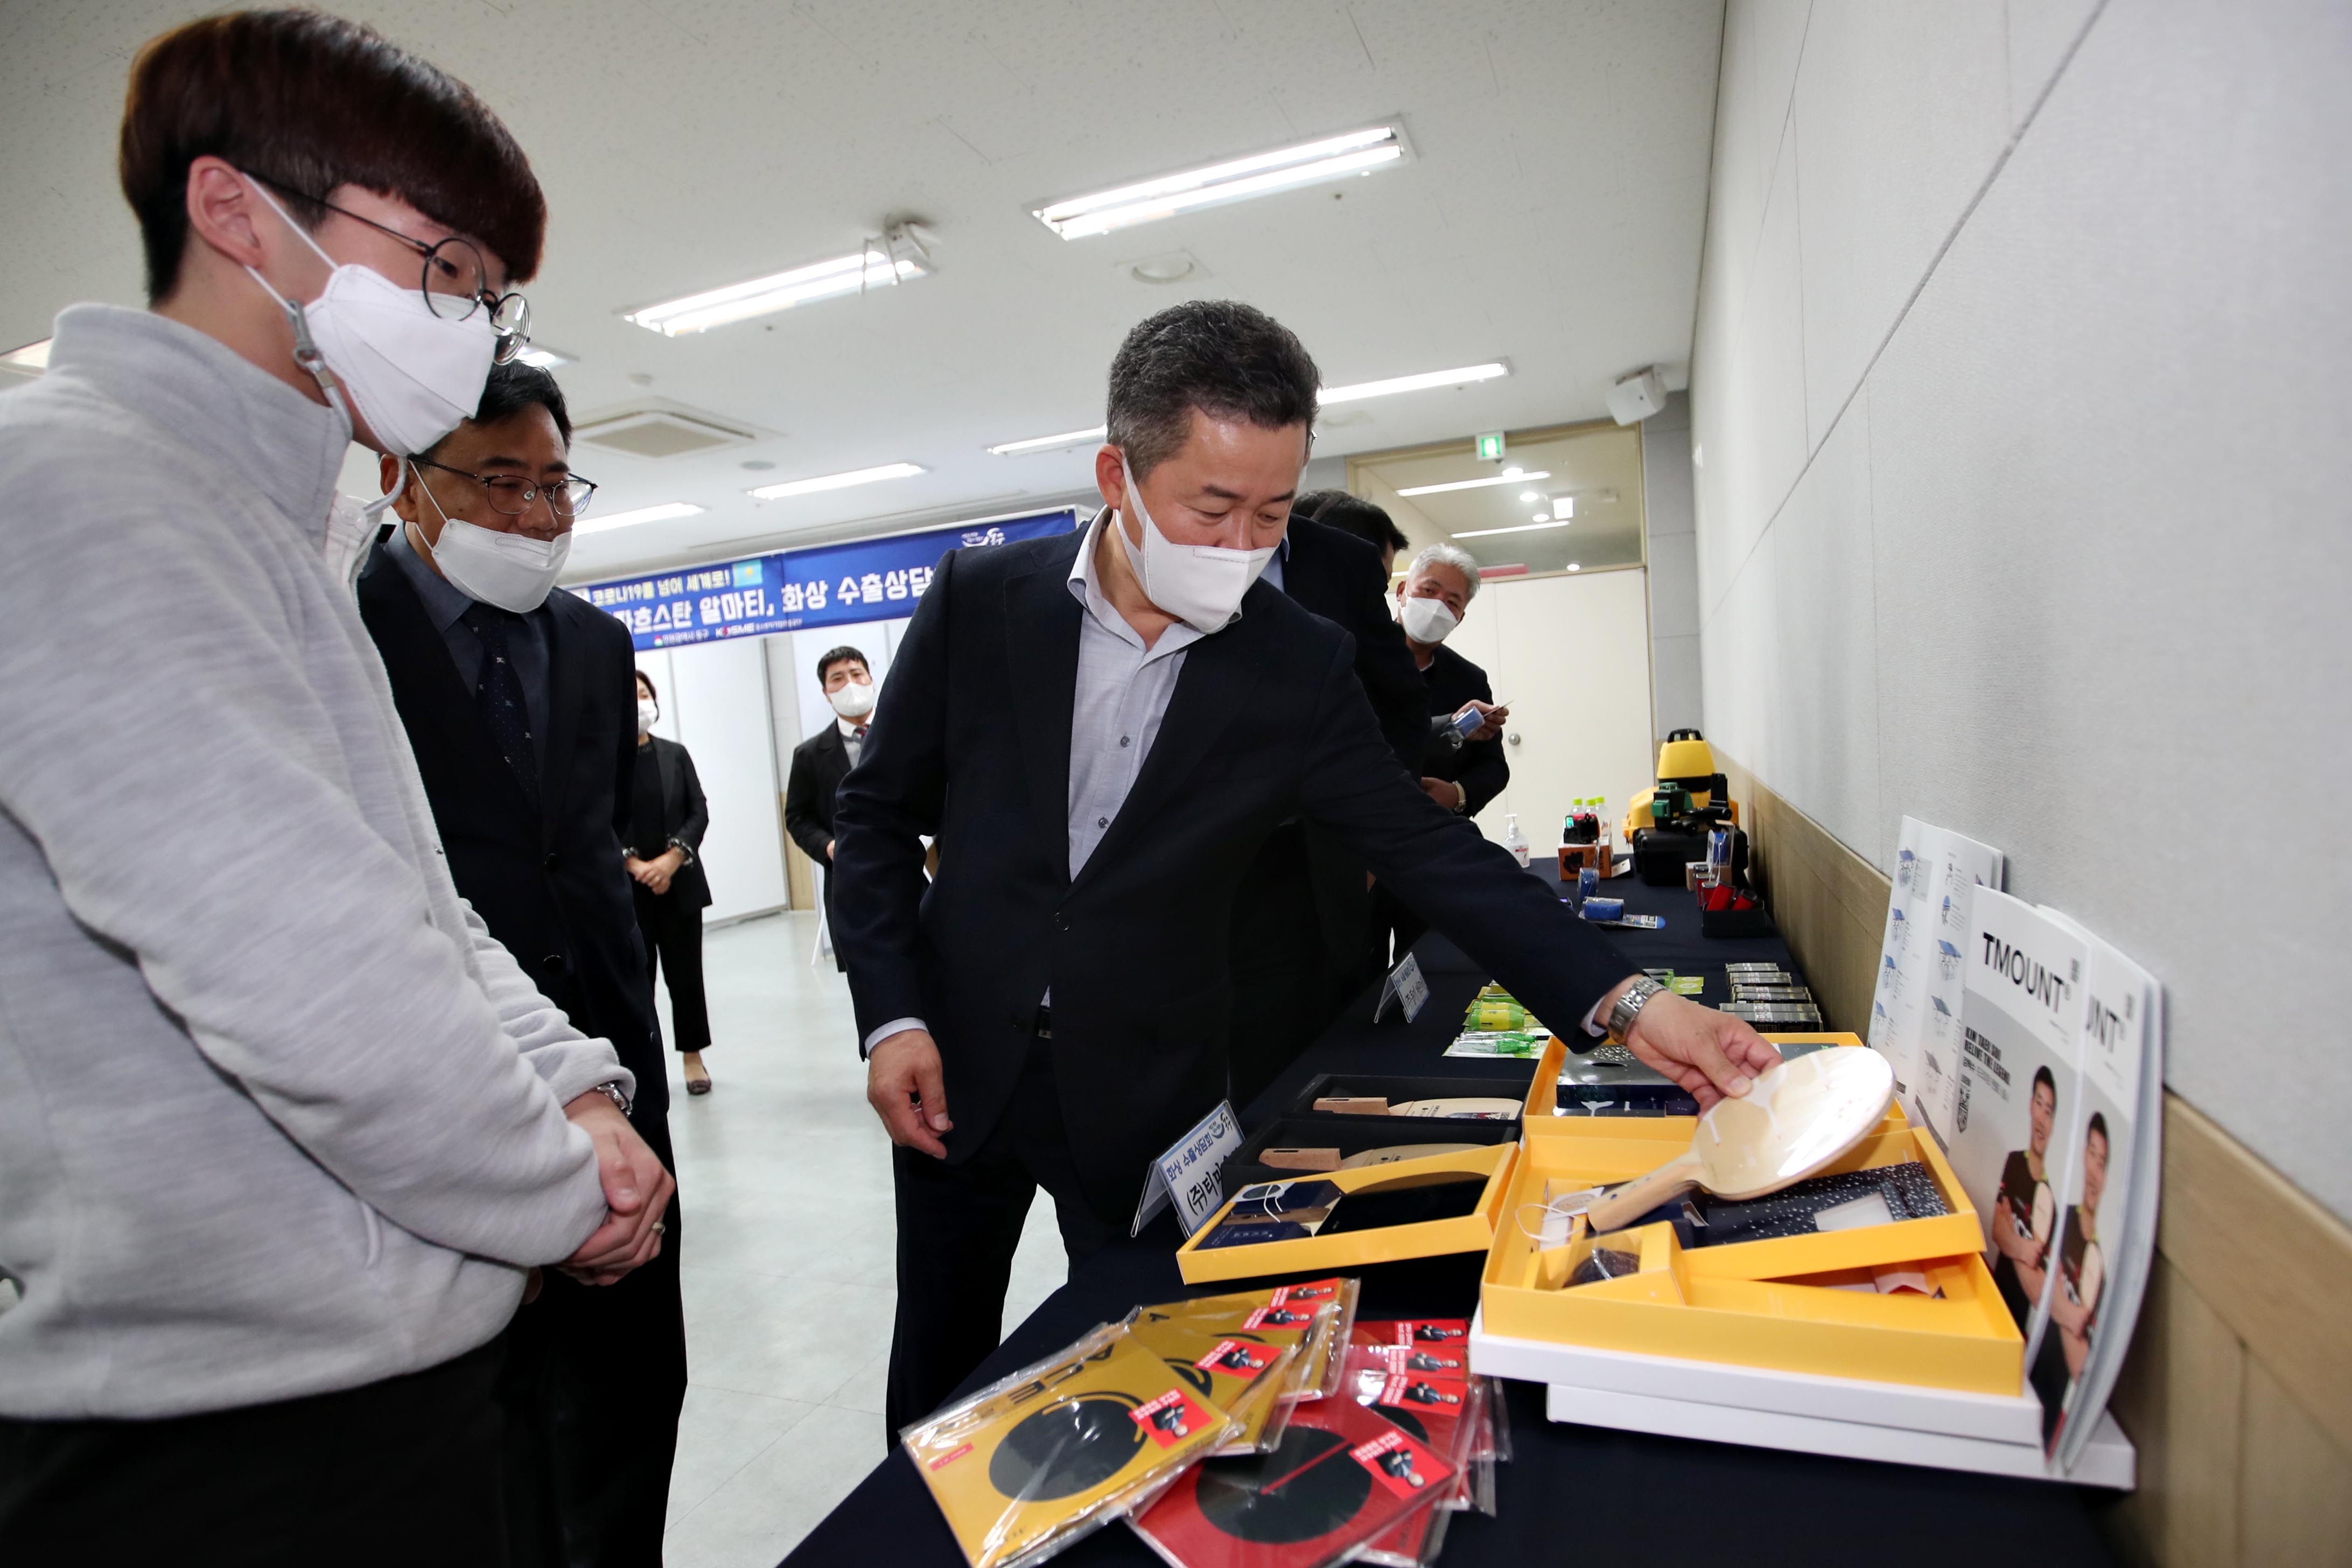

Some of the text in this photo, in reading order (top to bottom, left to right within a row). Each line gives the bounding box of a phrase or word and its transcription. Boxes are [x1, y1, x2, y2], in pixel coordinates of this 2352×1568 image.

[592, 569, 730, 606] 코로나19를 넘어 세계로!
[608, 566, 936, 634] 자흐스탄 알마티」 화상 수출상담
[715, 622, 754, 638] KOSME
[1983, 931, 2064, 1013] TMOUNT
[1166, 1132, 1214, 1182] 화상 수출상담회
